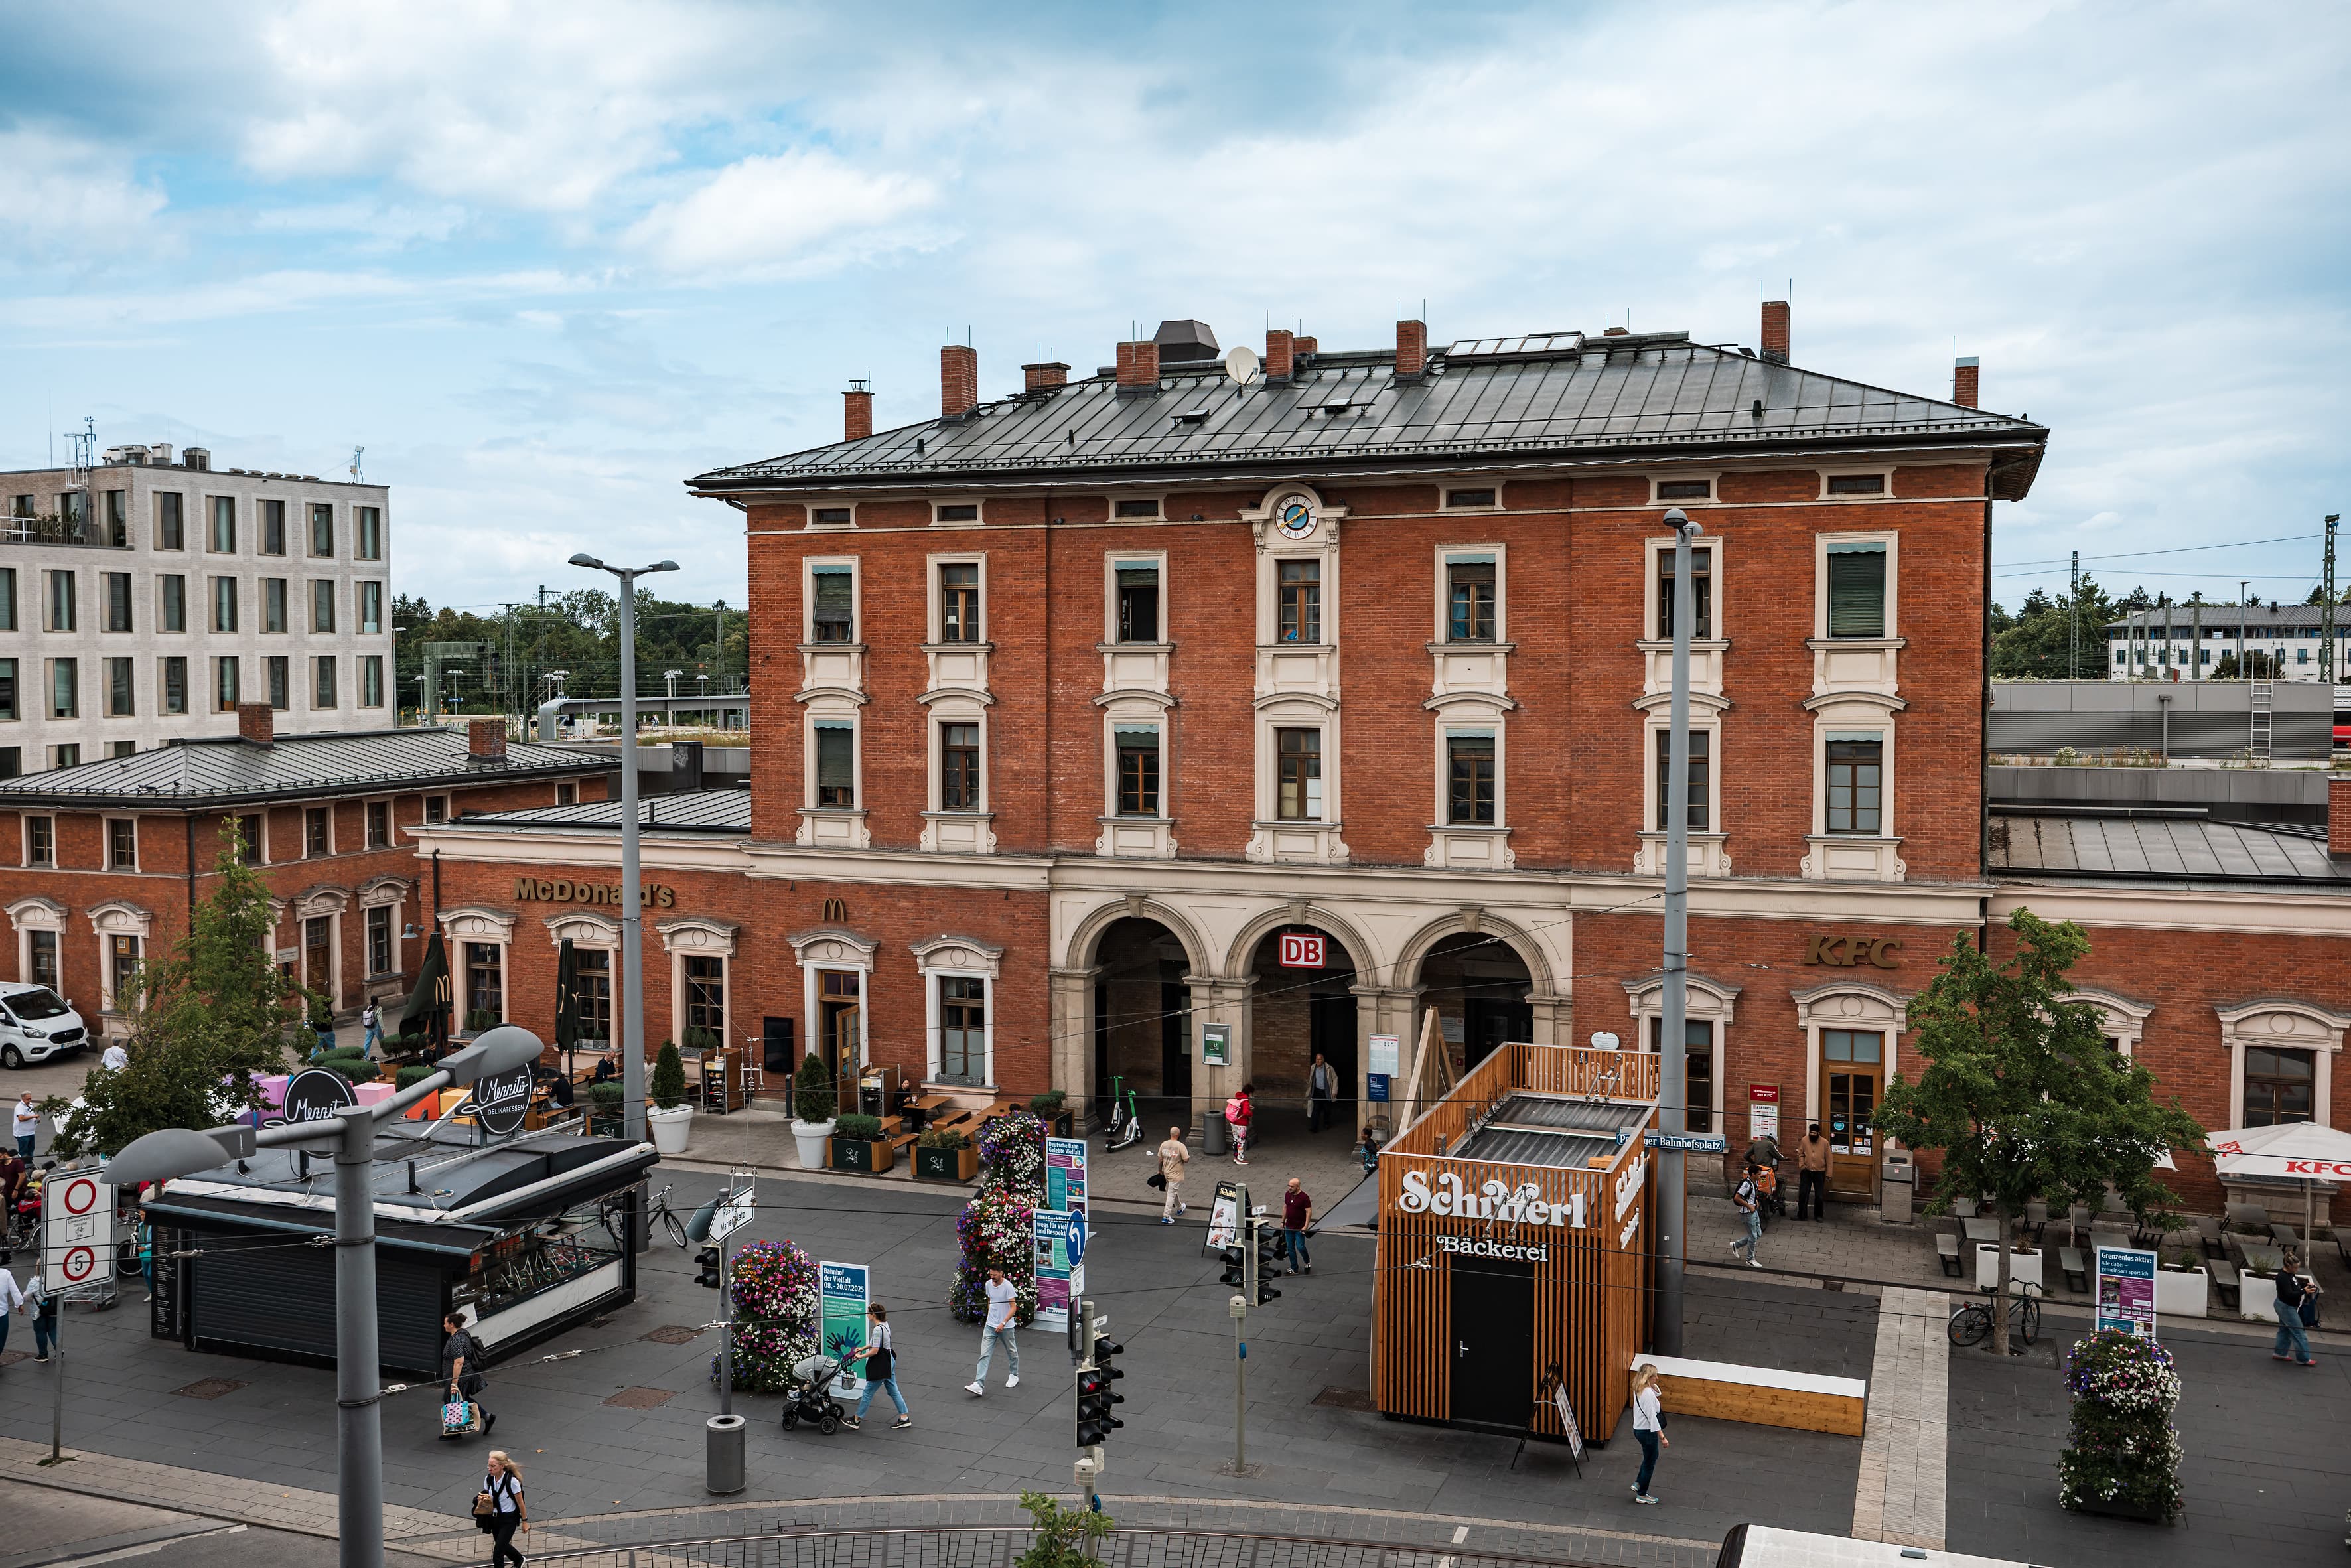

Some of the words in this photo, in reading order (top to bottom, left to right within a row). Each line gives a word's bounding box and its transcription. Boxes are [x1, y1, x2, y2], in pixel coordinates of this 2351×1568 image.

[514, 878, 672, 907] McDonad's
[1285, 938, 1320, 963] DB
[1805, 935, 1902, 968] KFC
[479, 1074, 529, 1104] Mezzito
[287, 1098, 344, 1122] Mezzit
[488, 1104, 525, 1115] DELIKATESSEN
[1620, 1135, 1657, 1147] Pager
[1660, 1137, 1721, 1150] Bahnhofsplatz
[2285, 1161, 2351, 1176] KFC
[721, 1211, 745, 1232] Marielatz
[1436, 1236, 1548, 1261] Bäckerei
[2102, 1252, 2134, 1262] Grenzenlos
[74, 1255, 83, 1271] 5
[833, 1275, 851, 1284] Vielfalt
[836, 1283, 864, 1293] 20.07.2025
